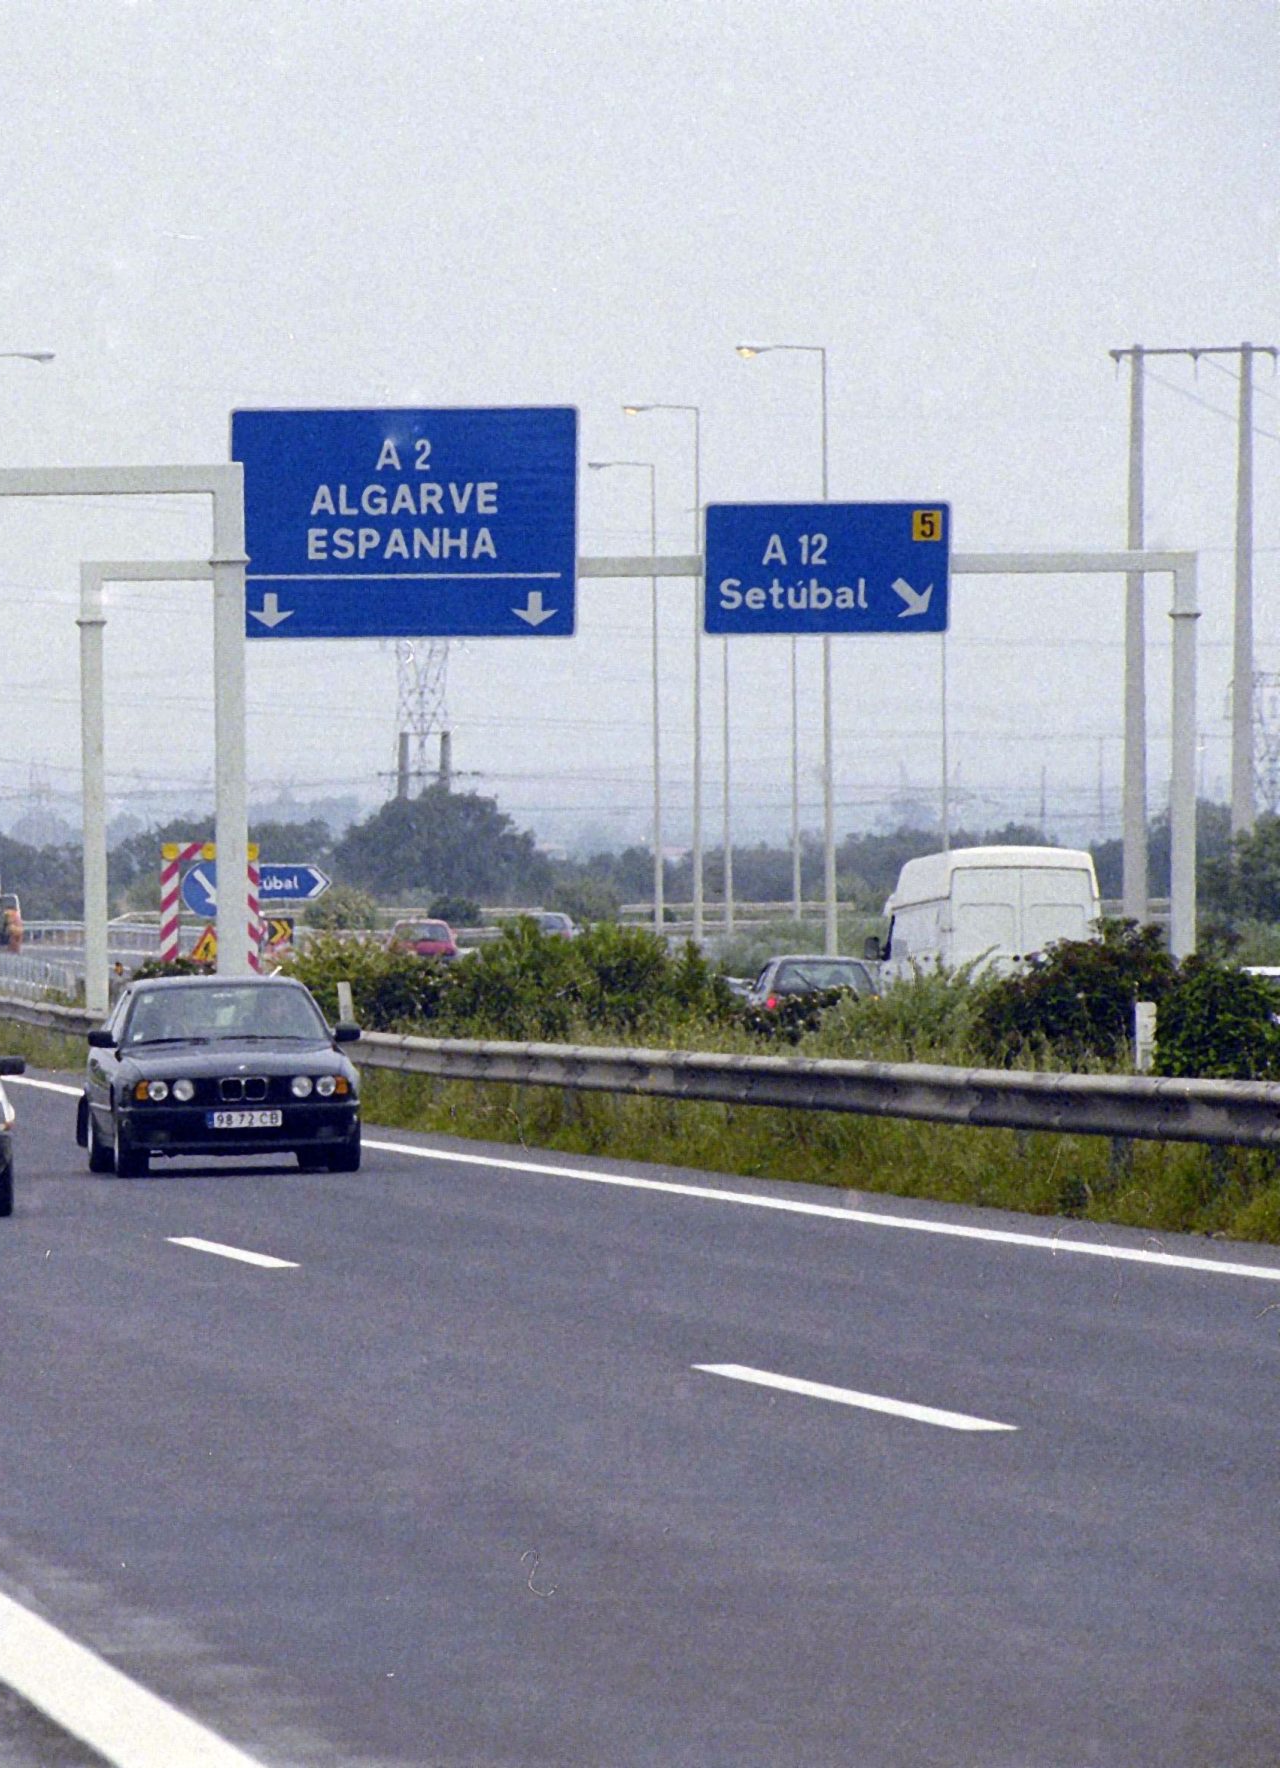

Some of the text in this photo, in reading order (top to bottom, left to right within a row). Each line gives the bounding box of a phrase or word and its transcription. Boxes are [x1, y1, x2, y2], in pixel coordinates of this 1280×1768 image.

[375, 438, 432, 471] A 2
[310, 482, 499, 516] ALGARVE
[920, 512, 935, 539] 5
[307, 527, 497, 560] ESPANHA
[762, 533, 828, 566] A 12
[719, 577, 869, 610] Setúbal
